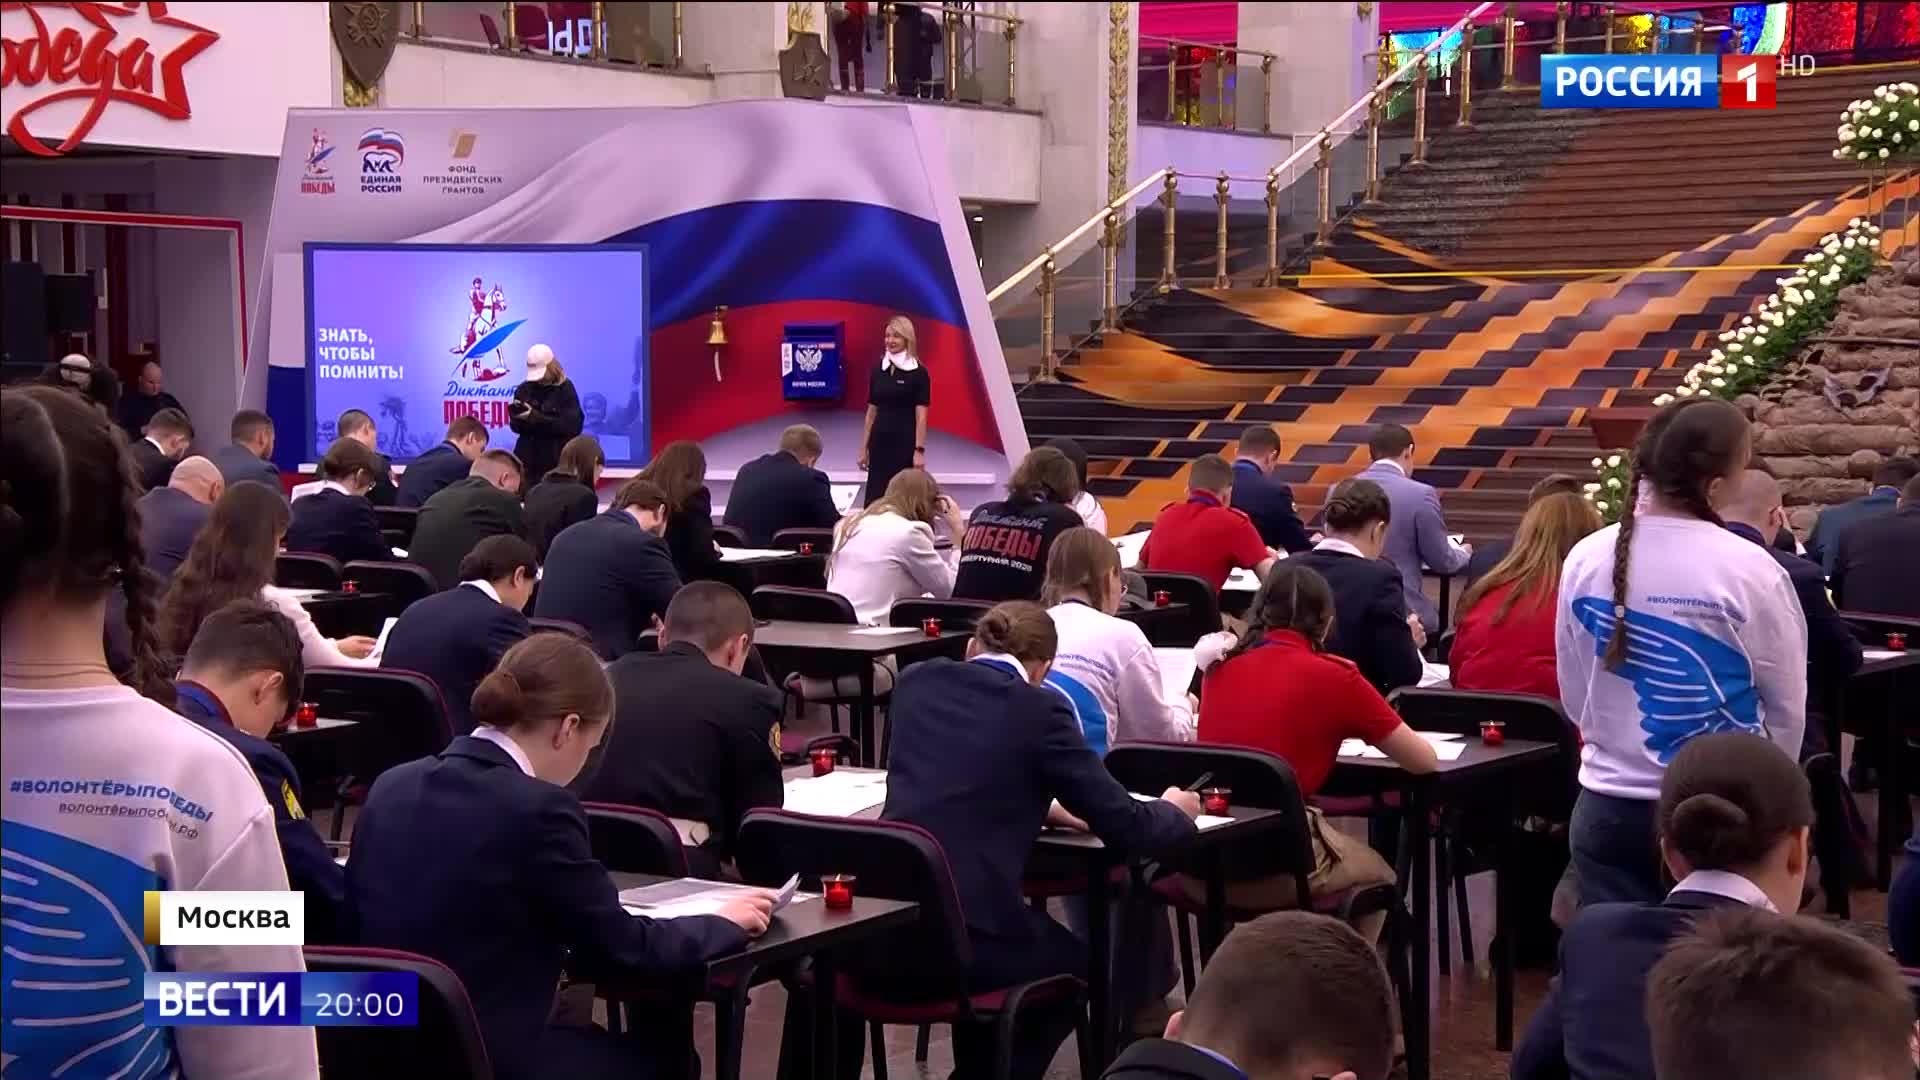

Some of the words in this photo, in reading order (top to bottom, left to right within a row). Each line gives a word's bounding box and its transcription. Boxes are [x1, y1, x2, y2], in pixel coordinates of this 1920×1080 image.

[448, 165, 476, 174] ФОНД
[361, 175, 402, 184] ЕДИНАЯ
[423, 175, 503, 185] ПРЕЗИДЕНТСКИХ
[361, 184, 402, 194] РОССИЯ
[442, 186, 485, 195] ГРАНТОВ
[319, 327, 373, 345] ЗНАТЬ,
[319, 346, 375, 361] ЧТОБЫ
[319, 364, 404, 380] ПОМНИТЬ!
[962, 525, 1042, 561] ПОБЕДЫ
